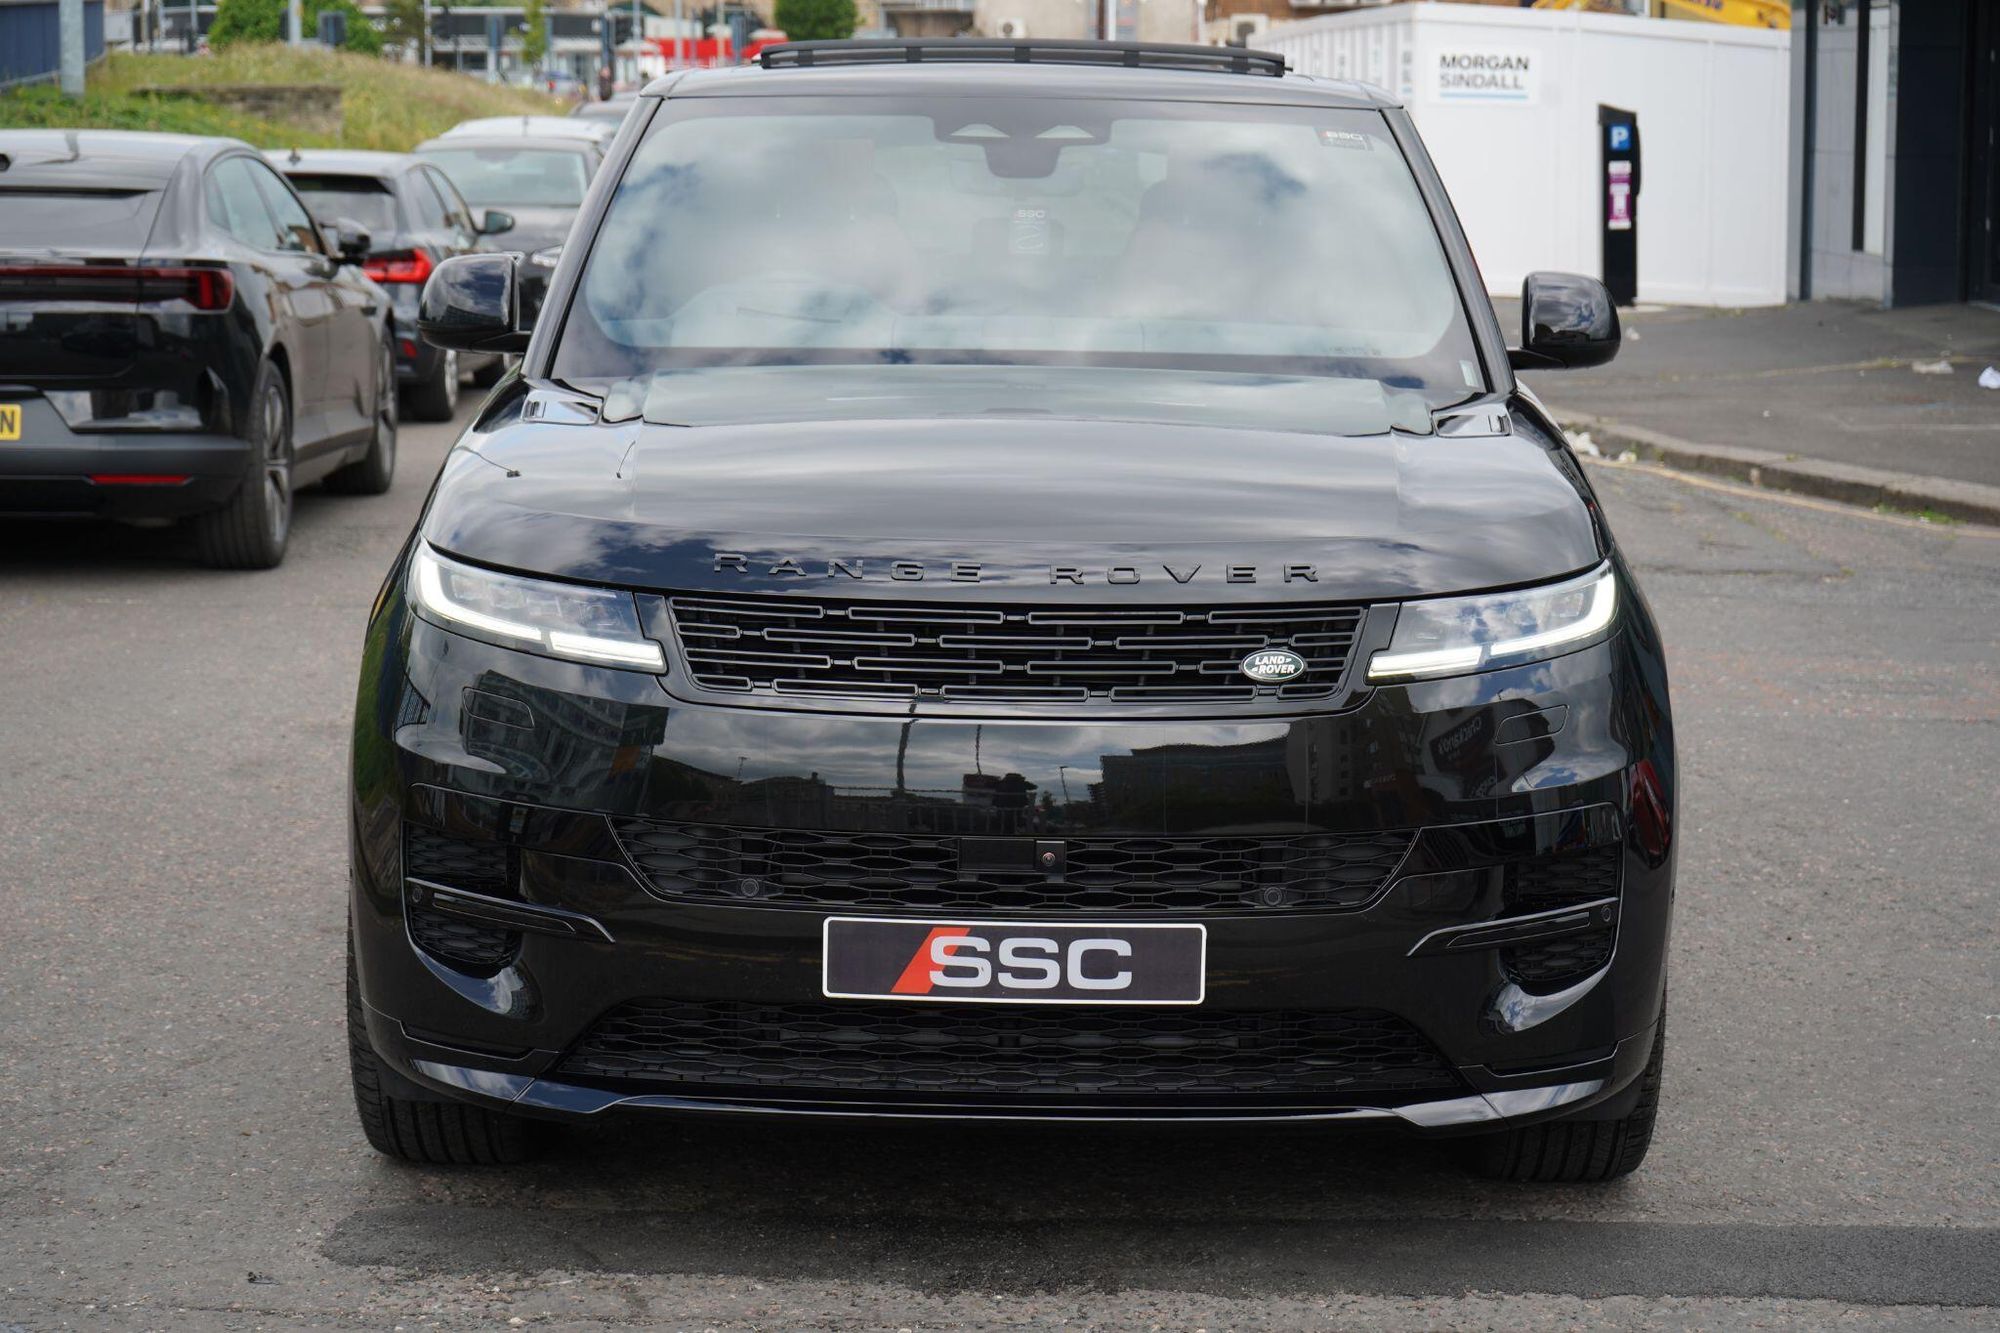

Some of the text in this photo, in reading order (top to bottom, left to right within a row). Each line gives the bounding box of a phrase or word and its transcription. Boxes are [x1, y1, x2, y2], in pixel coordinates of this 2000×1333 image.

[1440, 53, 1530, 71] MORGAN
[1440, 73, 1524, 89] SINDALL
[1611, 125, 1629, 149] P
[713, 552, 1319, 585] RANGE ROVER
[1254, 655, 1285, 665] LAND
[1258, 664, 1295, 674] ROVER
[929, 935, 1133, 990] SSC
